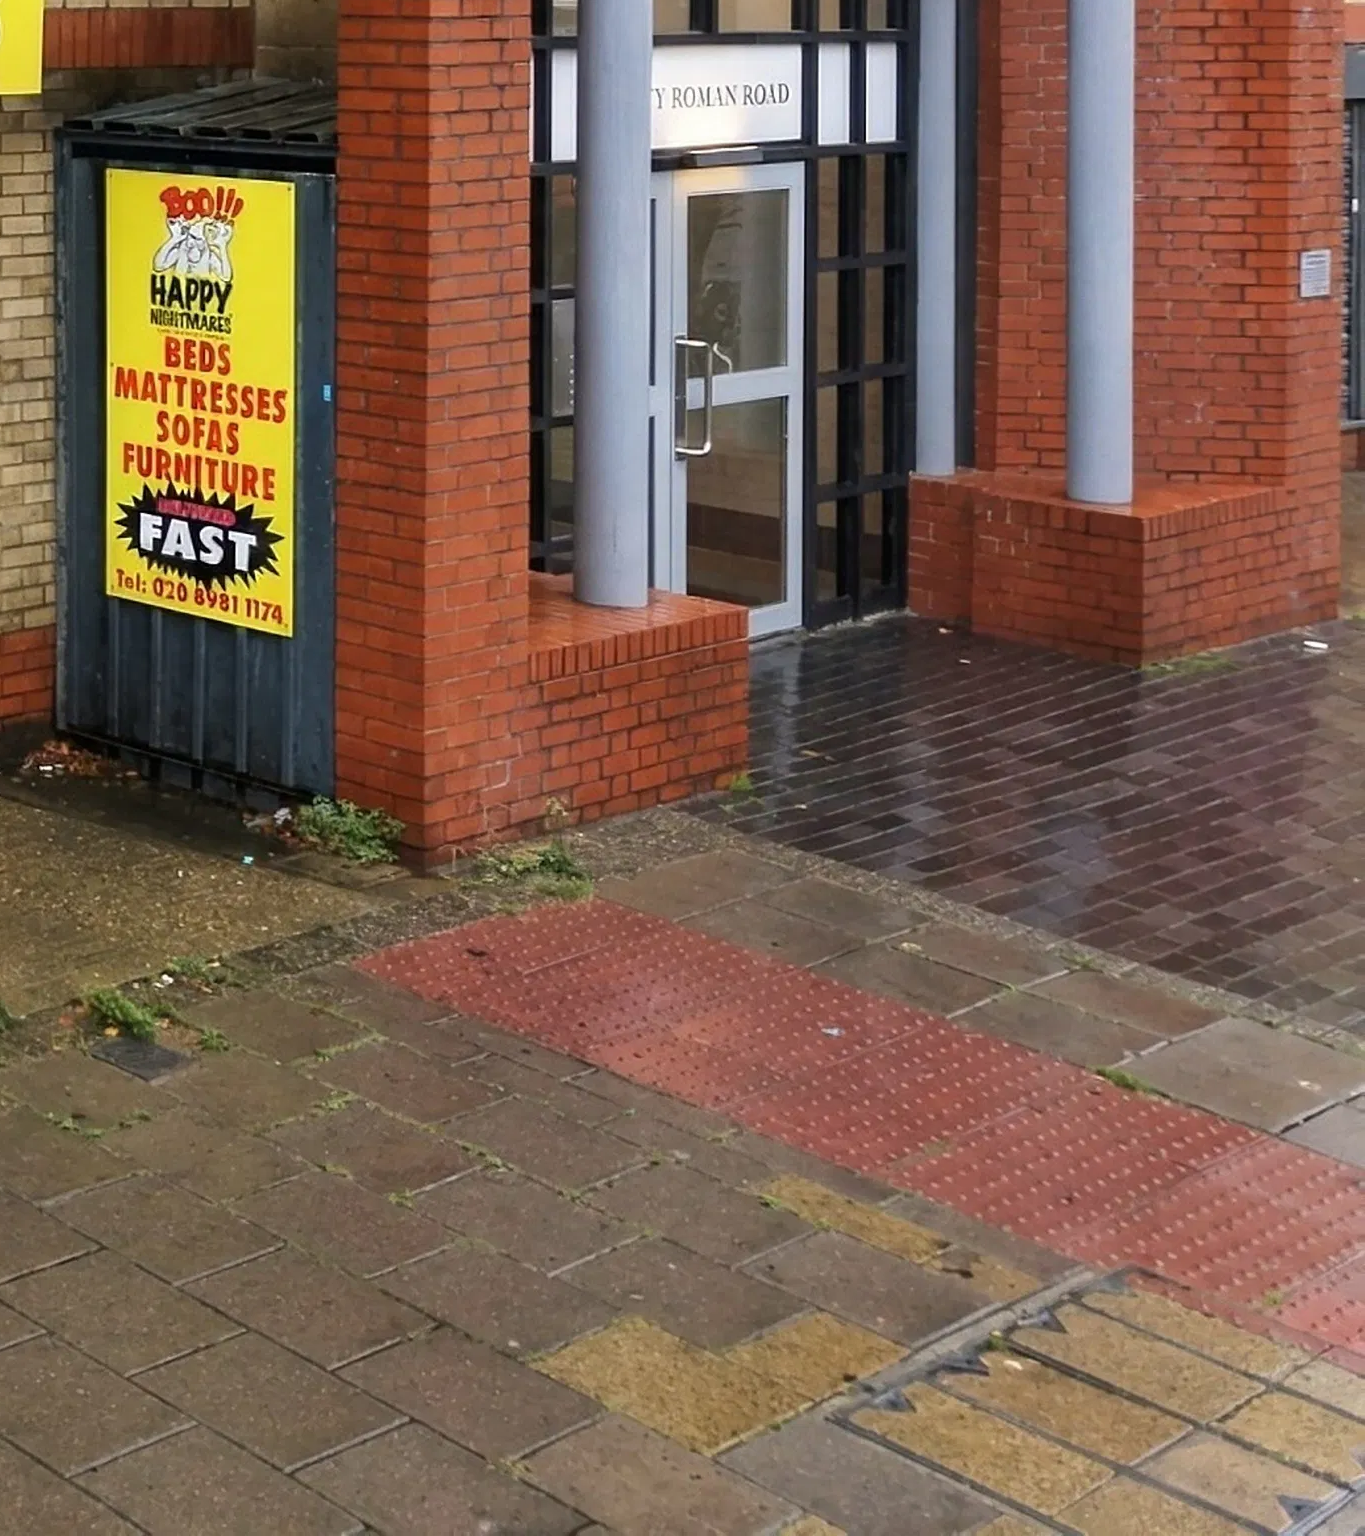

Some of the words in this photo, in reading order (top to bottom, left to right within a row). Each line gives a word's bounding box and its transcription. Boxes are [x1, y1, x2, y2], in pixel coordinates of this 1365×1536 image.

[671, 84, 737, 109] ROMAN
[743, 82, 790, 106] ROAD
[159, 186, 245, 226] BOO!!!
[151, 273, 232, 314] HAPPY
[150, 308, 232, 334] NIGHTMARES
[165, 336, 231, 376] BEDS
[115, 366, 287, 423] MATTRESSES
[156, 410, 239, 455] SOFAS
[123, 442, 276, 501] FURNITURE
[139, 512, 257, 572] FAST
[116, 568, 146, 593] Tel:
[153, 577, 188, 602] 020
[194, 587, 238, 614] 8981
[245, 598, 283, 624] 1174
